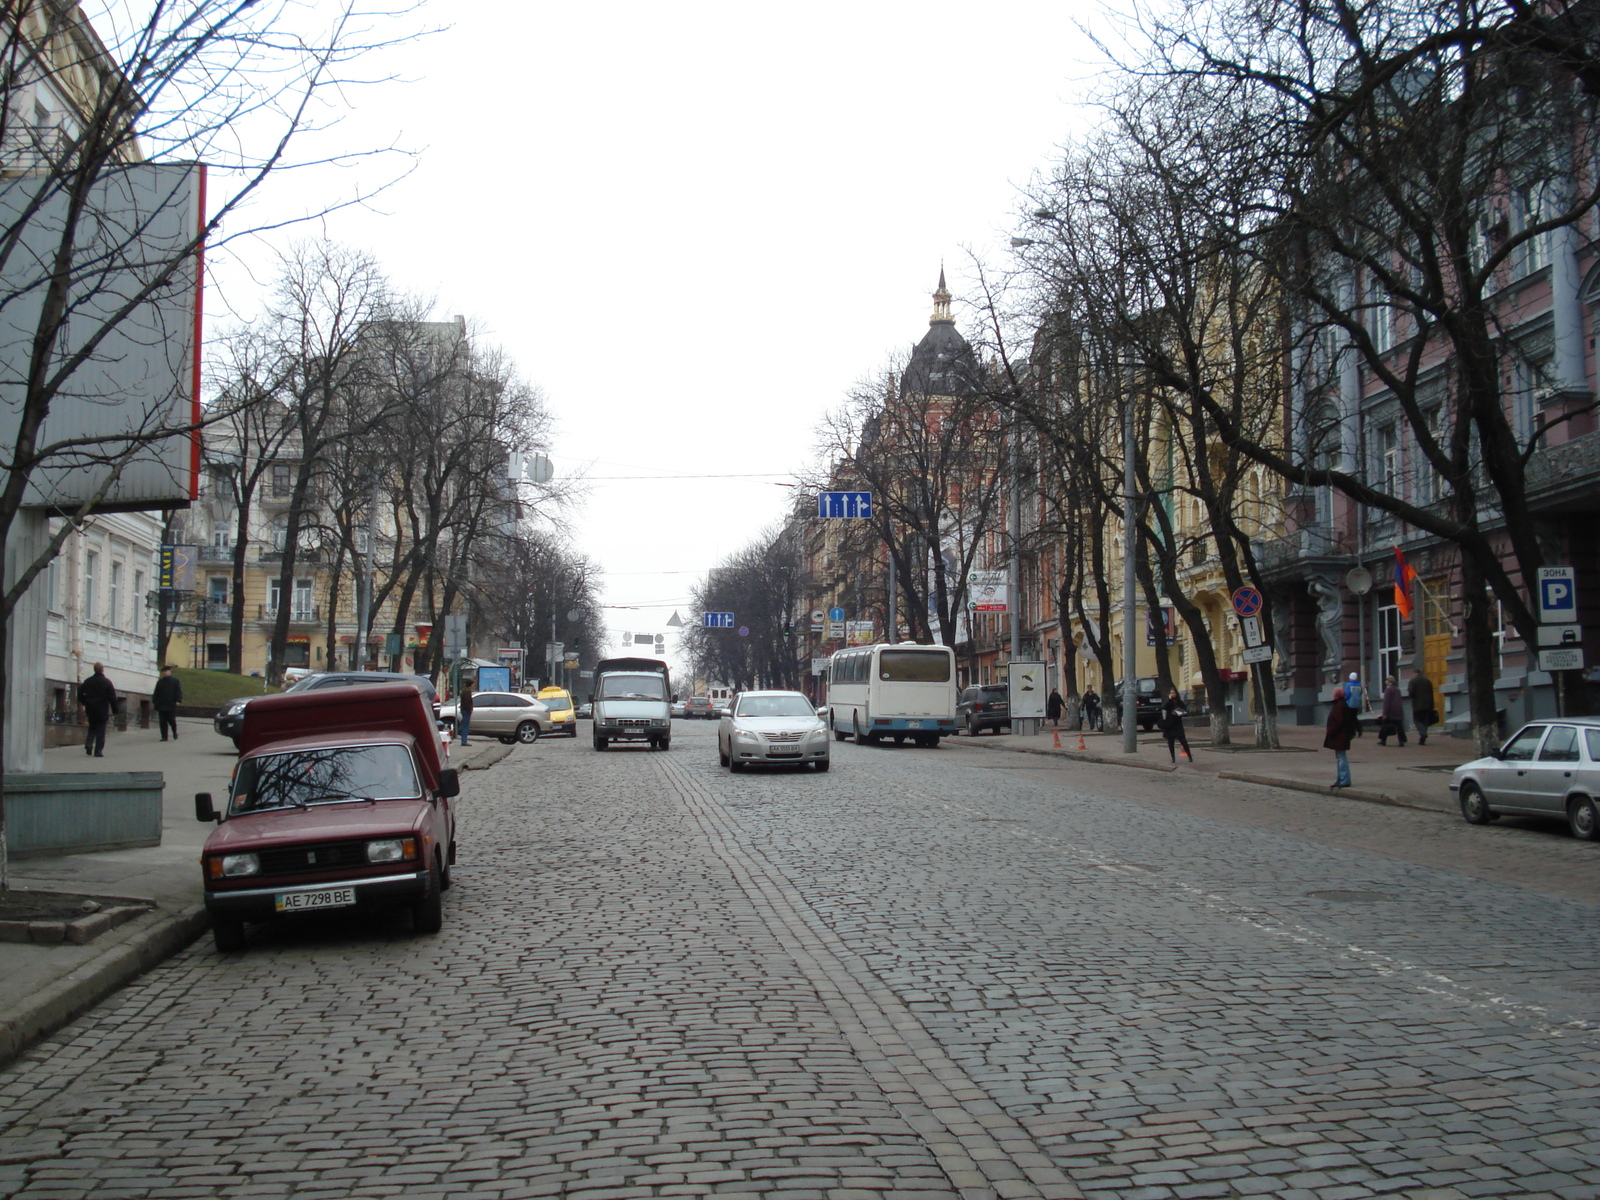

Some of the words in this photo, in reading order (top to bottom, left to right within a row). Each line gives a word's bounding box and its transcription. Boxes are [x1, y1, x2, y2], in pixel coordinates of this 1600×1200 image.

[1543, 569, 1567, 577] ЗОНА
[1547, 583, 1568, 606] P
[284, 895, 301, 908] AE
[303, 892, 332, 906] 7298
[334, 890, 352, 903] BE
